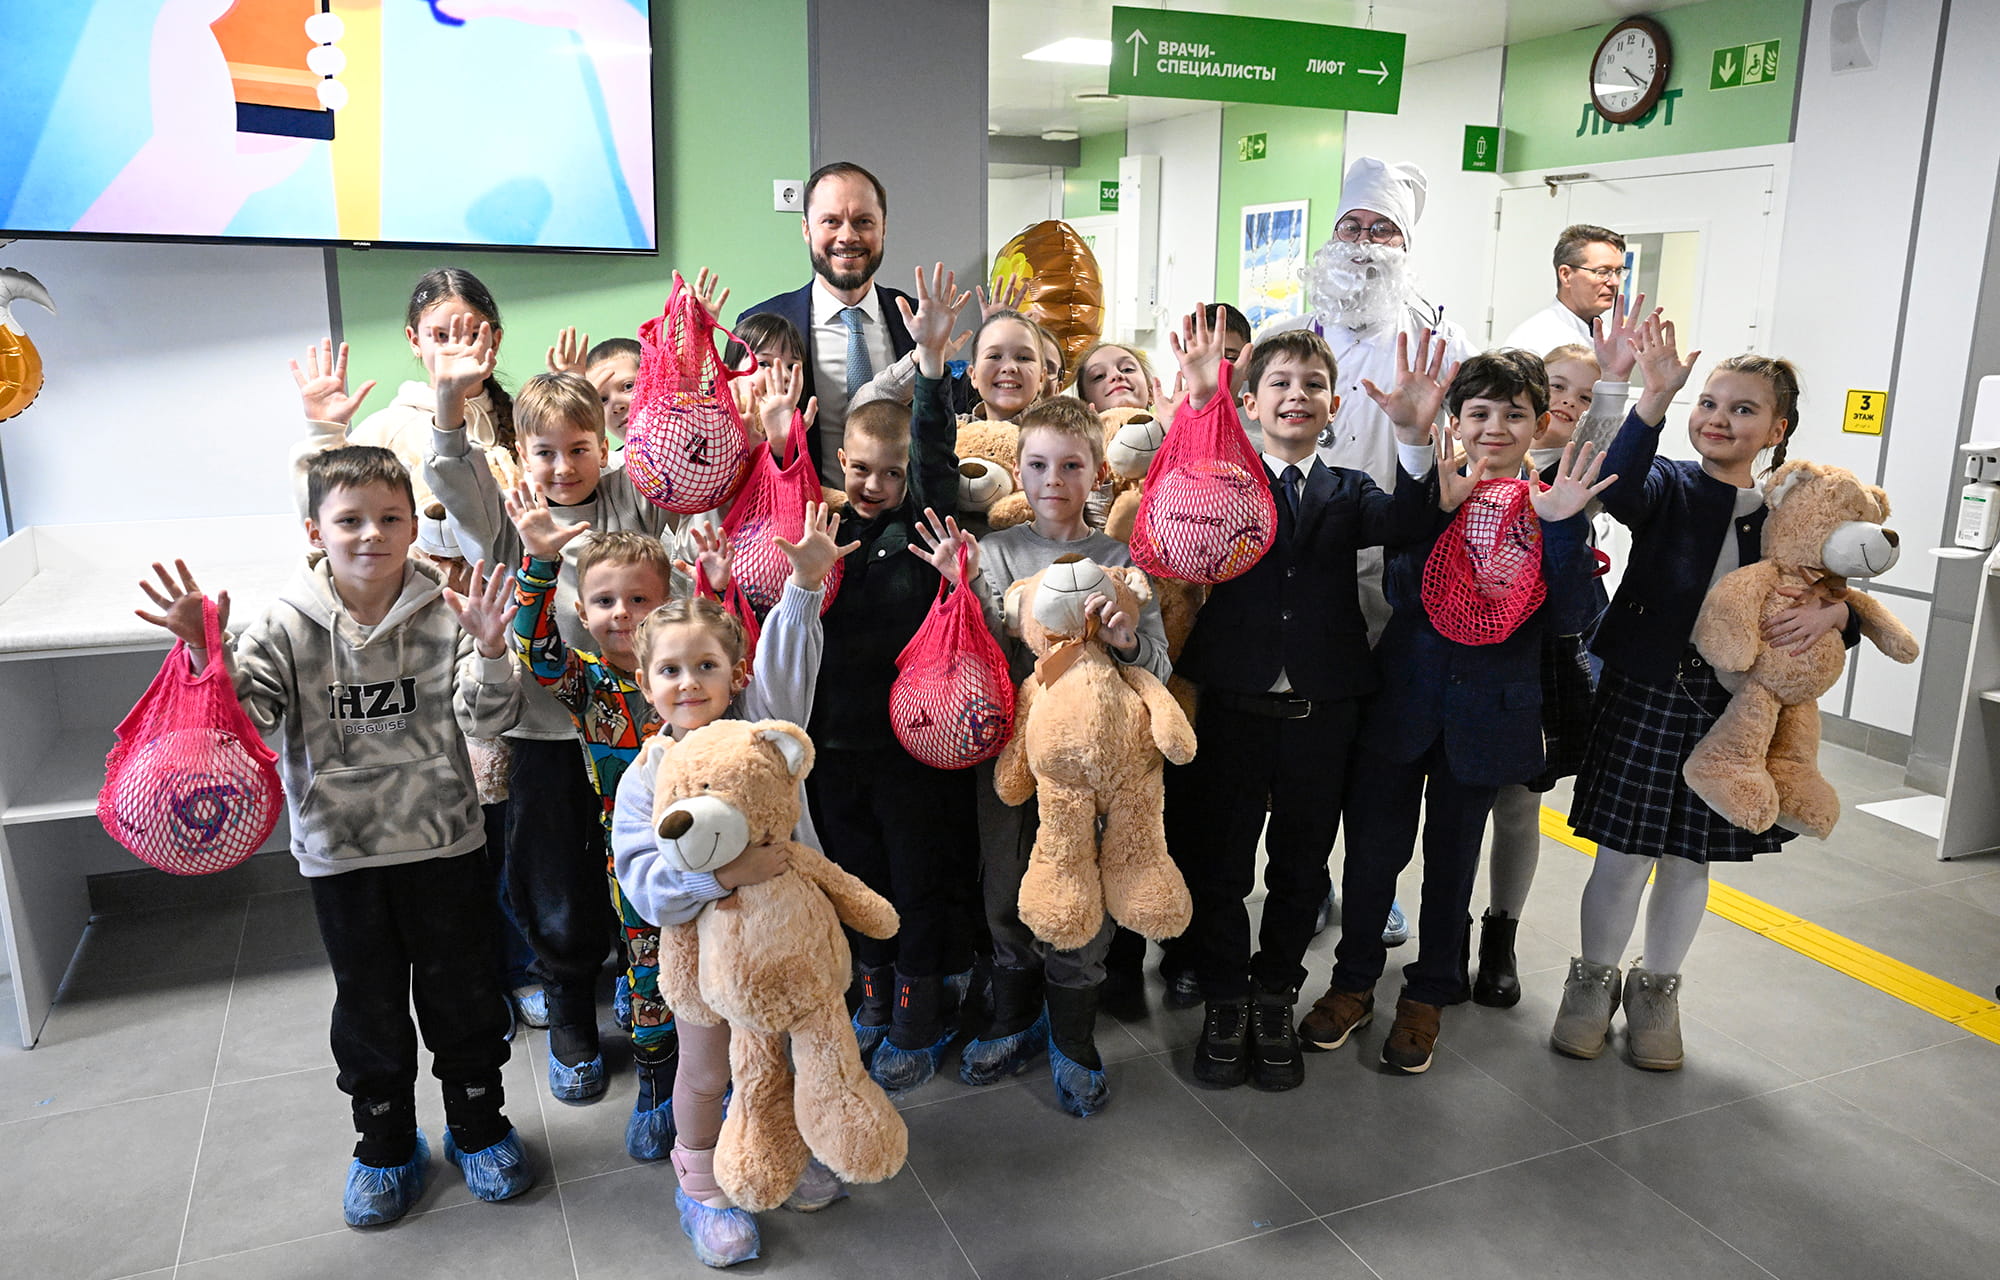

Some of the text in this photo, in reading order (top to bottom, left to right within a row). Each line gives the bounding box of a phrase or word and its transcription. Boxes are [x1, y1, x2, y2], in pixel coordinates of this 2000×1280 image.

[1617, 41, 1624, 51] 11
[1627, 34, 1636, 45] 12
[1158, 41, 1215, 58] ВРАЧИ-
[1156, 59, 1277, 81] СПЕЦИАЛИСТЫ
[1306, 59, 1346, 75] ЛИФТ
[1576, 88, 1683, 137] ЛТ
[1860, 395, 1871, 410] 3
[1853, 413, 1874, 421] ЭТАЖ
[327, 677, 418, 720] HZJ
[345, 720, 407, 735] DISGUISE
